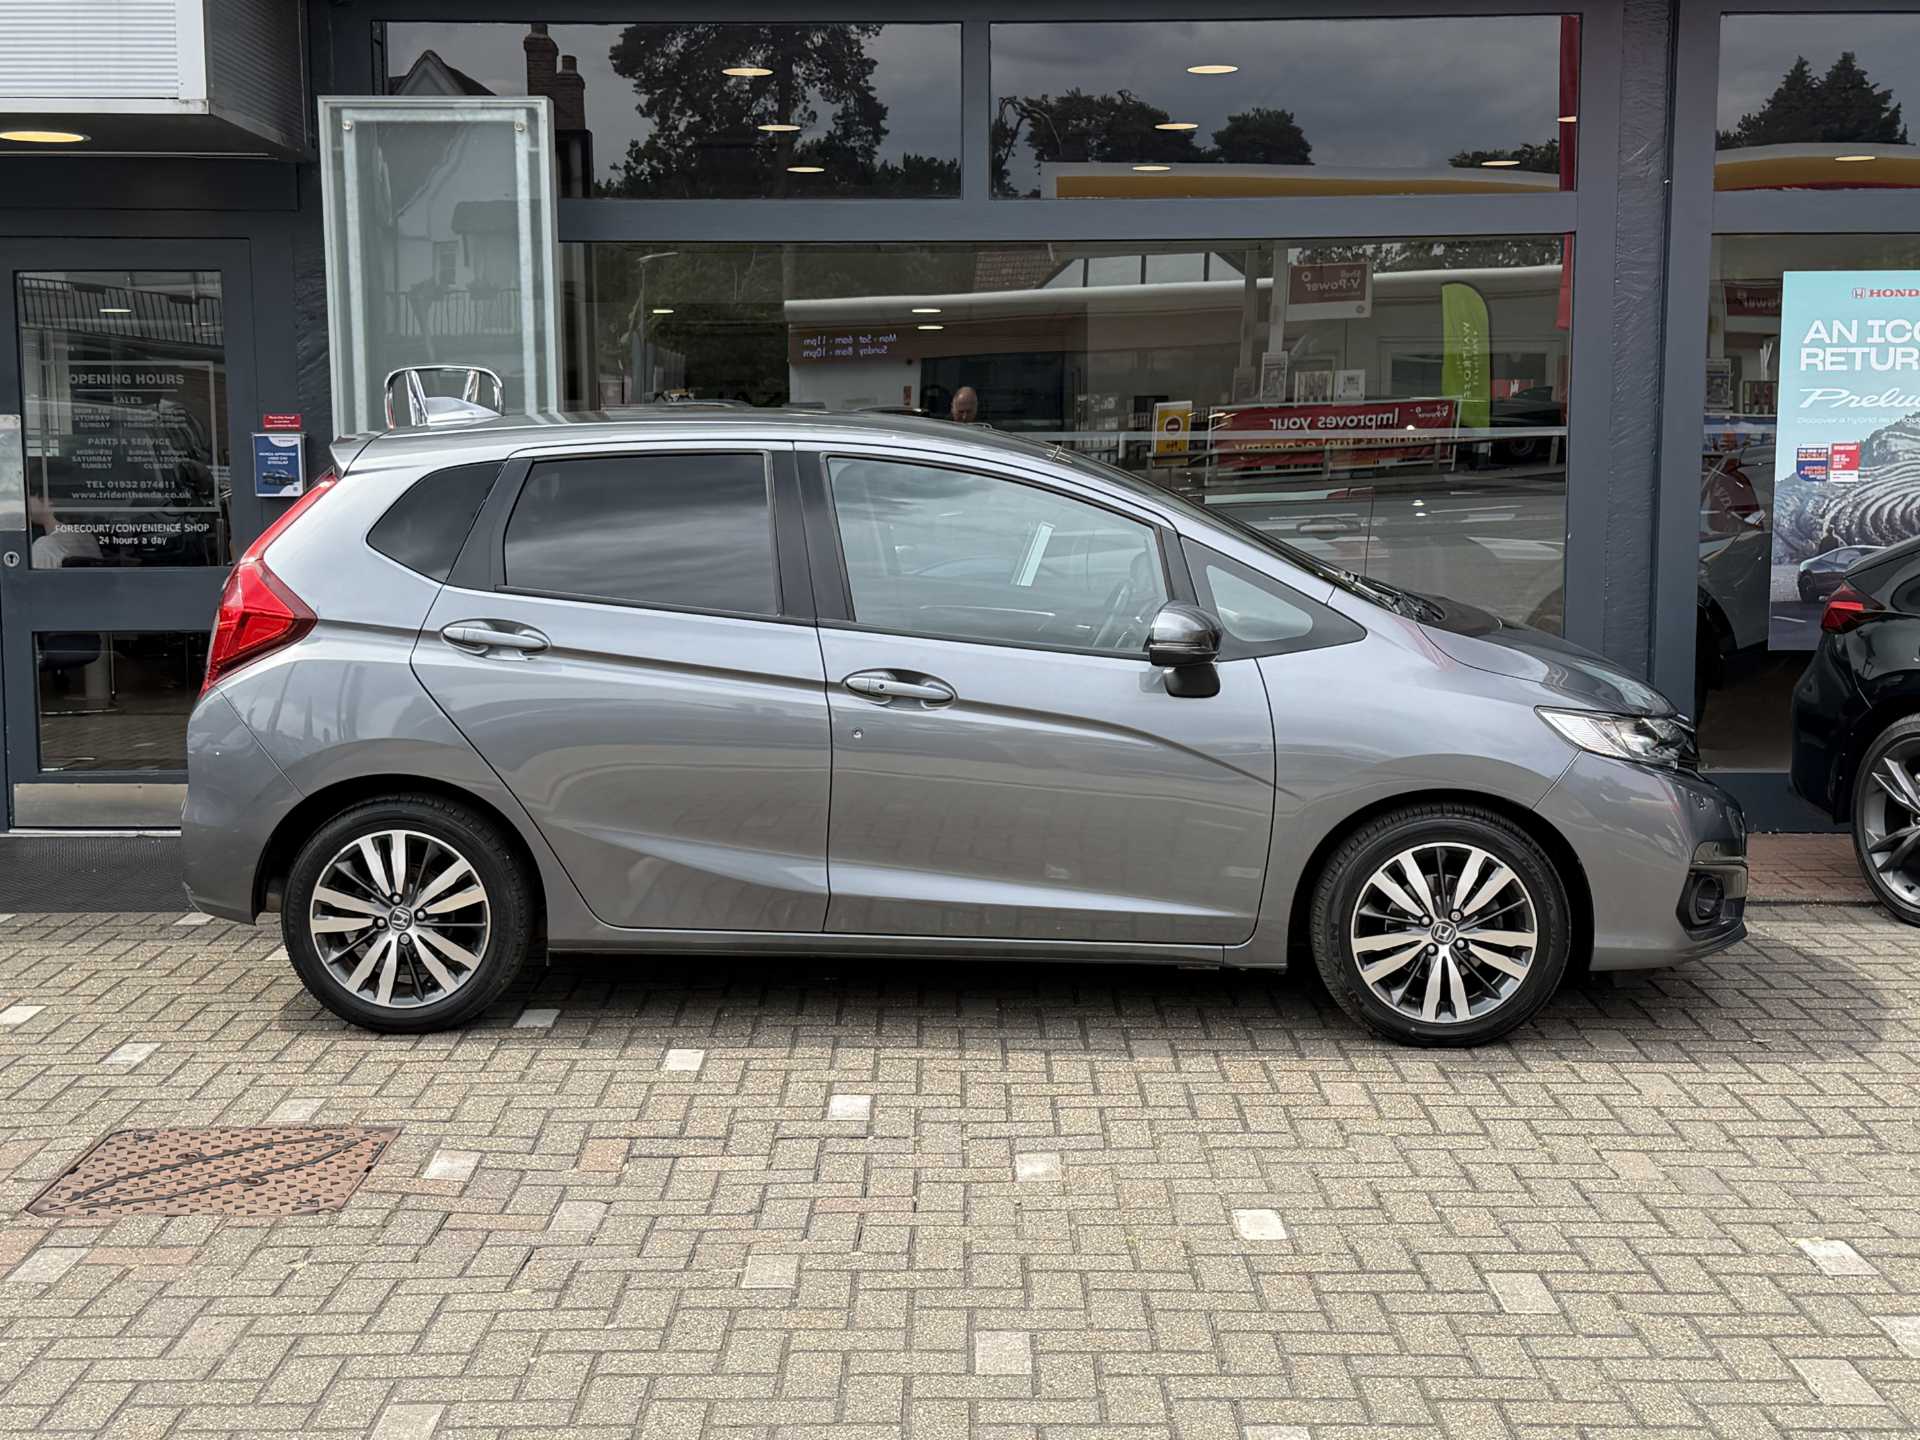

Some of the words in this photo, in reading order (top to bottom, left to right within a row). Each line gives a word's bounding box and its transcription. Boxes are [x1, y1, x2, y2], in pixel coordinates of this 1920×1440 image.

[1802, 319, 1858, 344] AN
[69, 374, 132, 385] OPENING
[135, 374, 185, 385] HOURS
[113, 396, 143, 405] SALES
[1799, 387, 1920, 408] Prelu
[88, 437, 118, 446] PARTS
[131, 437, 171, 446] SERVICE
[85, 480, 105, 489] TEL
[107, 480, 138, 489] 01932
[54, 523, 182, 534] FORECOURT/CONVENIENCE
[184, 523, 210, 533] SHOP
[98, 536, 110, 545] 24
[112, 536, 139, 545] hours
[151, 536, 167, 546] day
